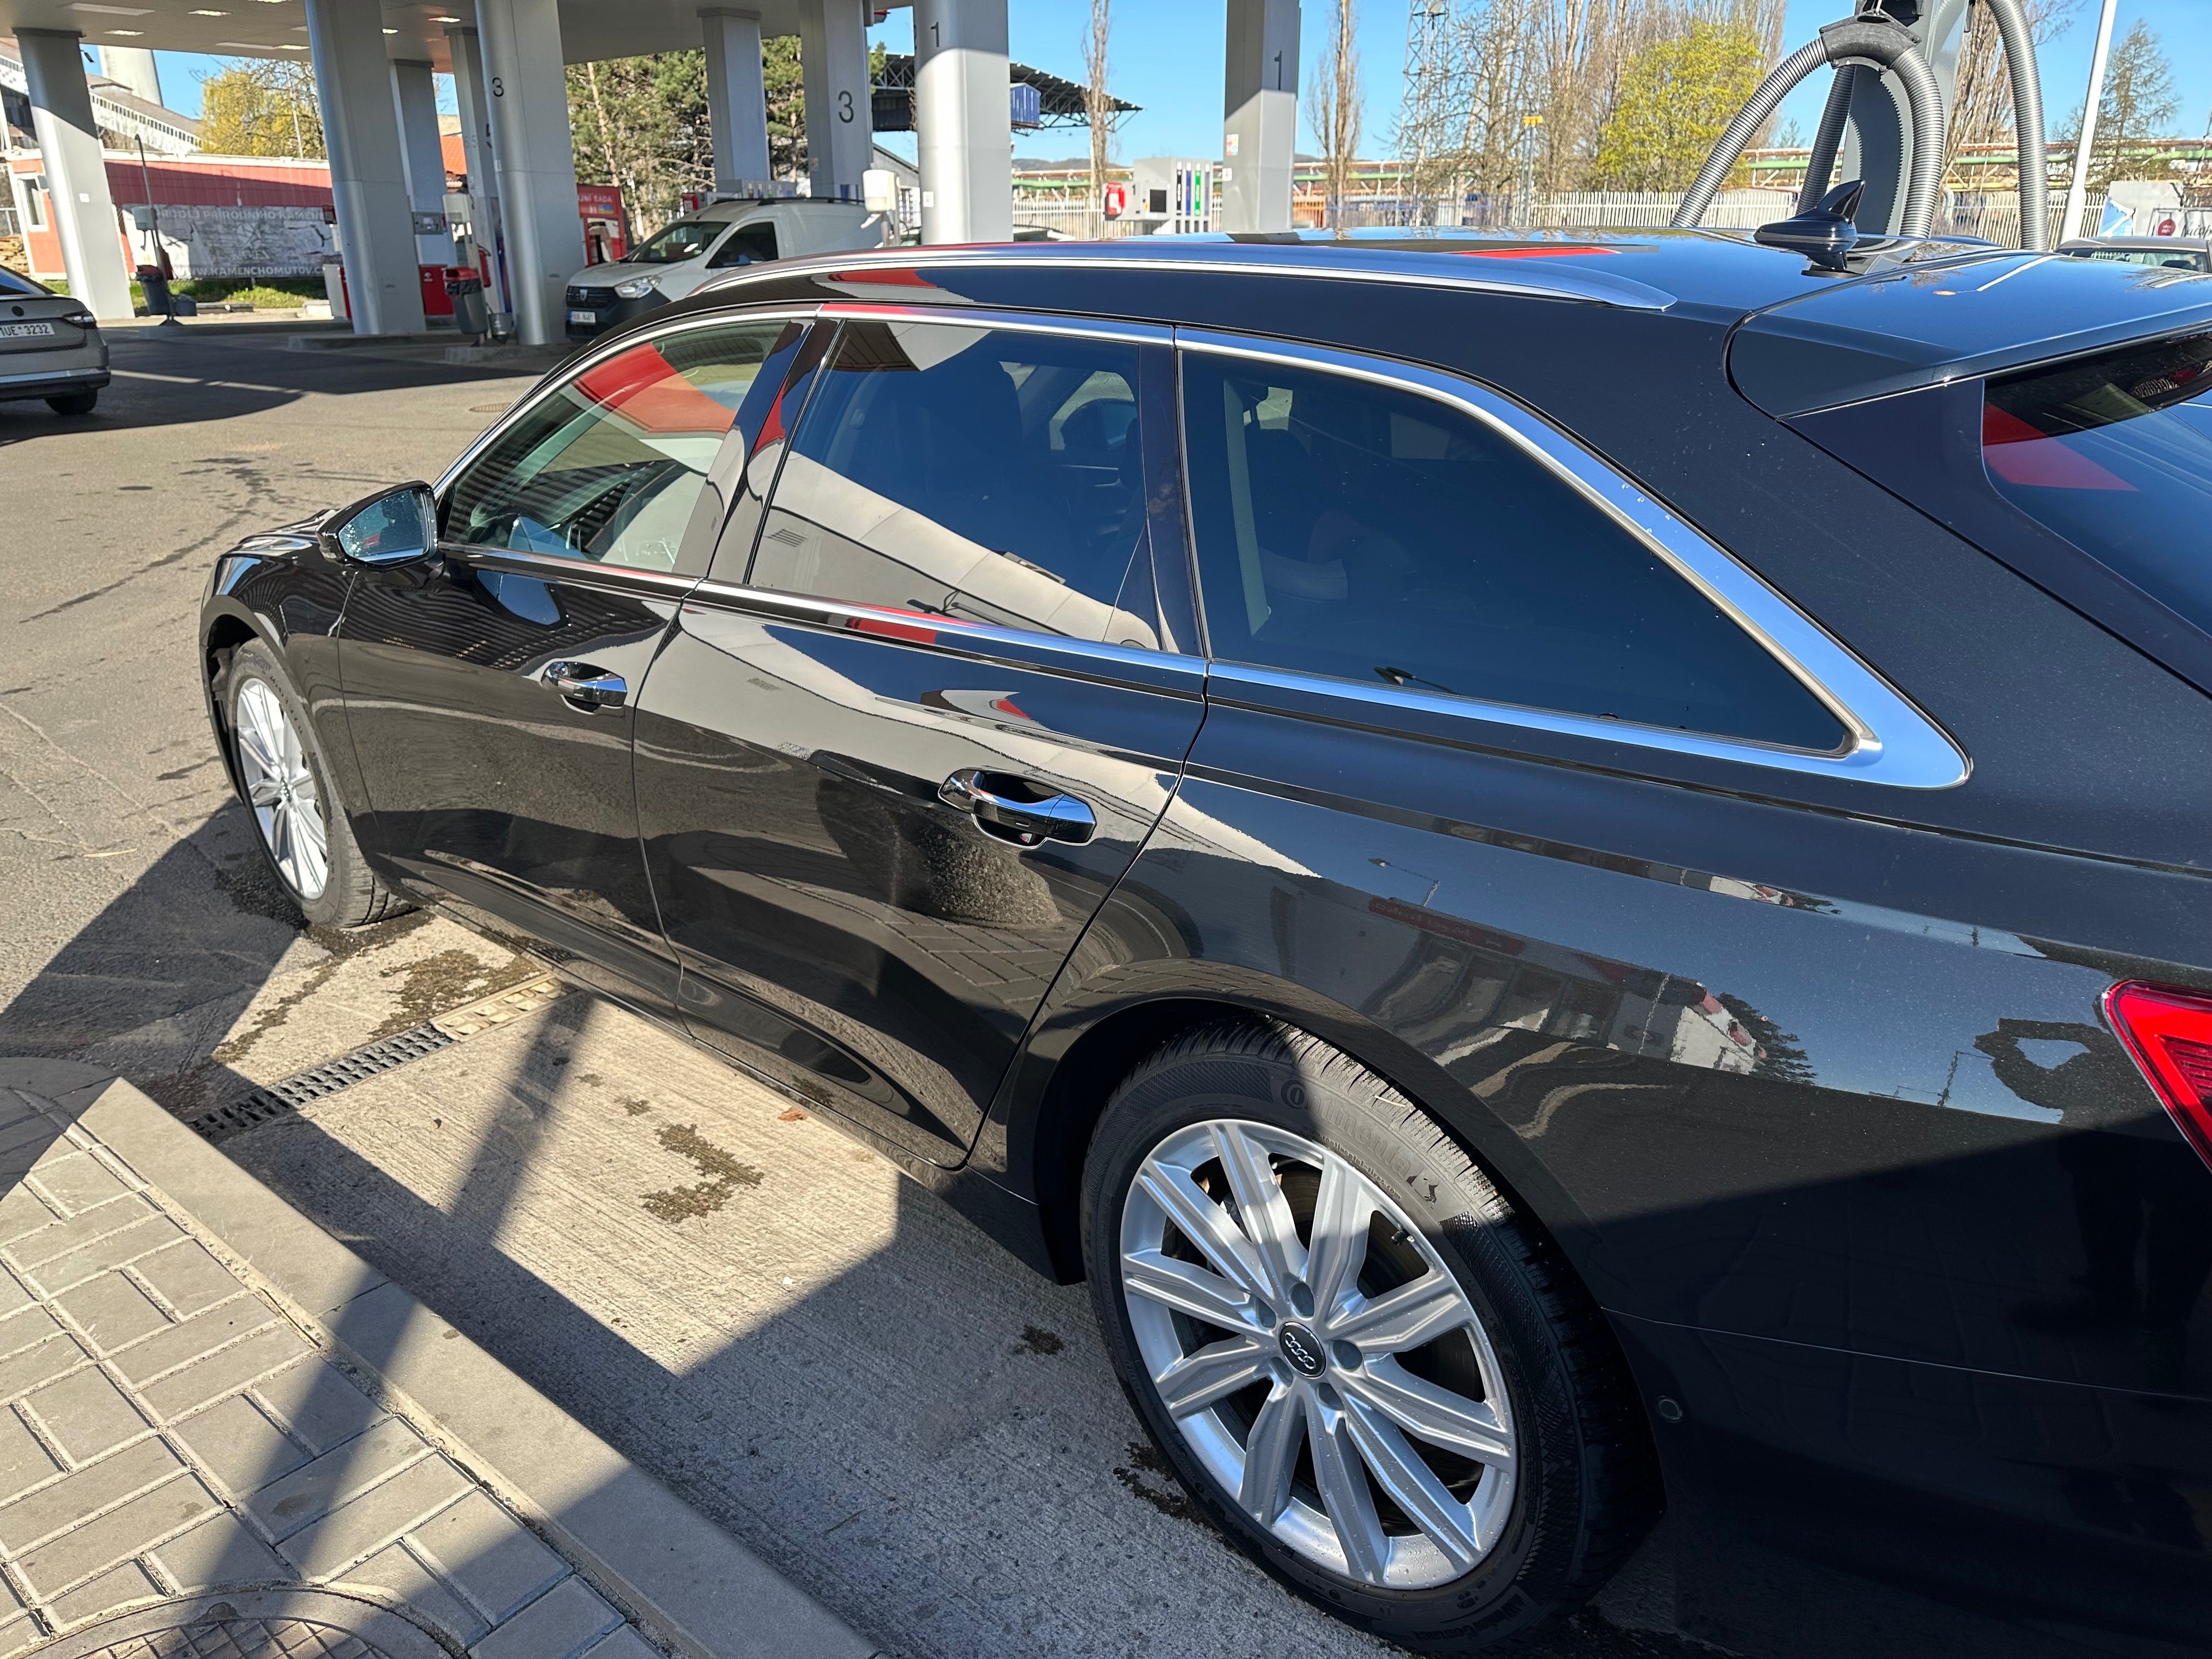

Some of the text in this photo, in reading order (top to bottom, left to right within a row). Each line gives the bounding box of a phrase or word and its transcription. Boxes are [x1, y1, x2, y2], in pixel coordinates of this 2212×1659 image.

[930, 21, 939, 48] 1
[1274, 50, 1282, 91] 1
[492, 77, 504, 97] 3
[838, 90, 854, 123] 3
[174, 265, 324, 276] WWW.KAMENCHOMUTOV.C
[24, 324, 50, 335] 3232
[1280, 1079, 1425, 1188] Continental
